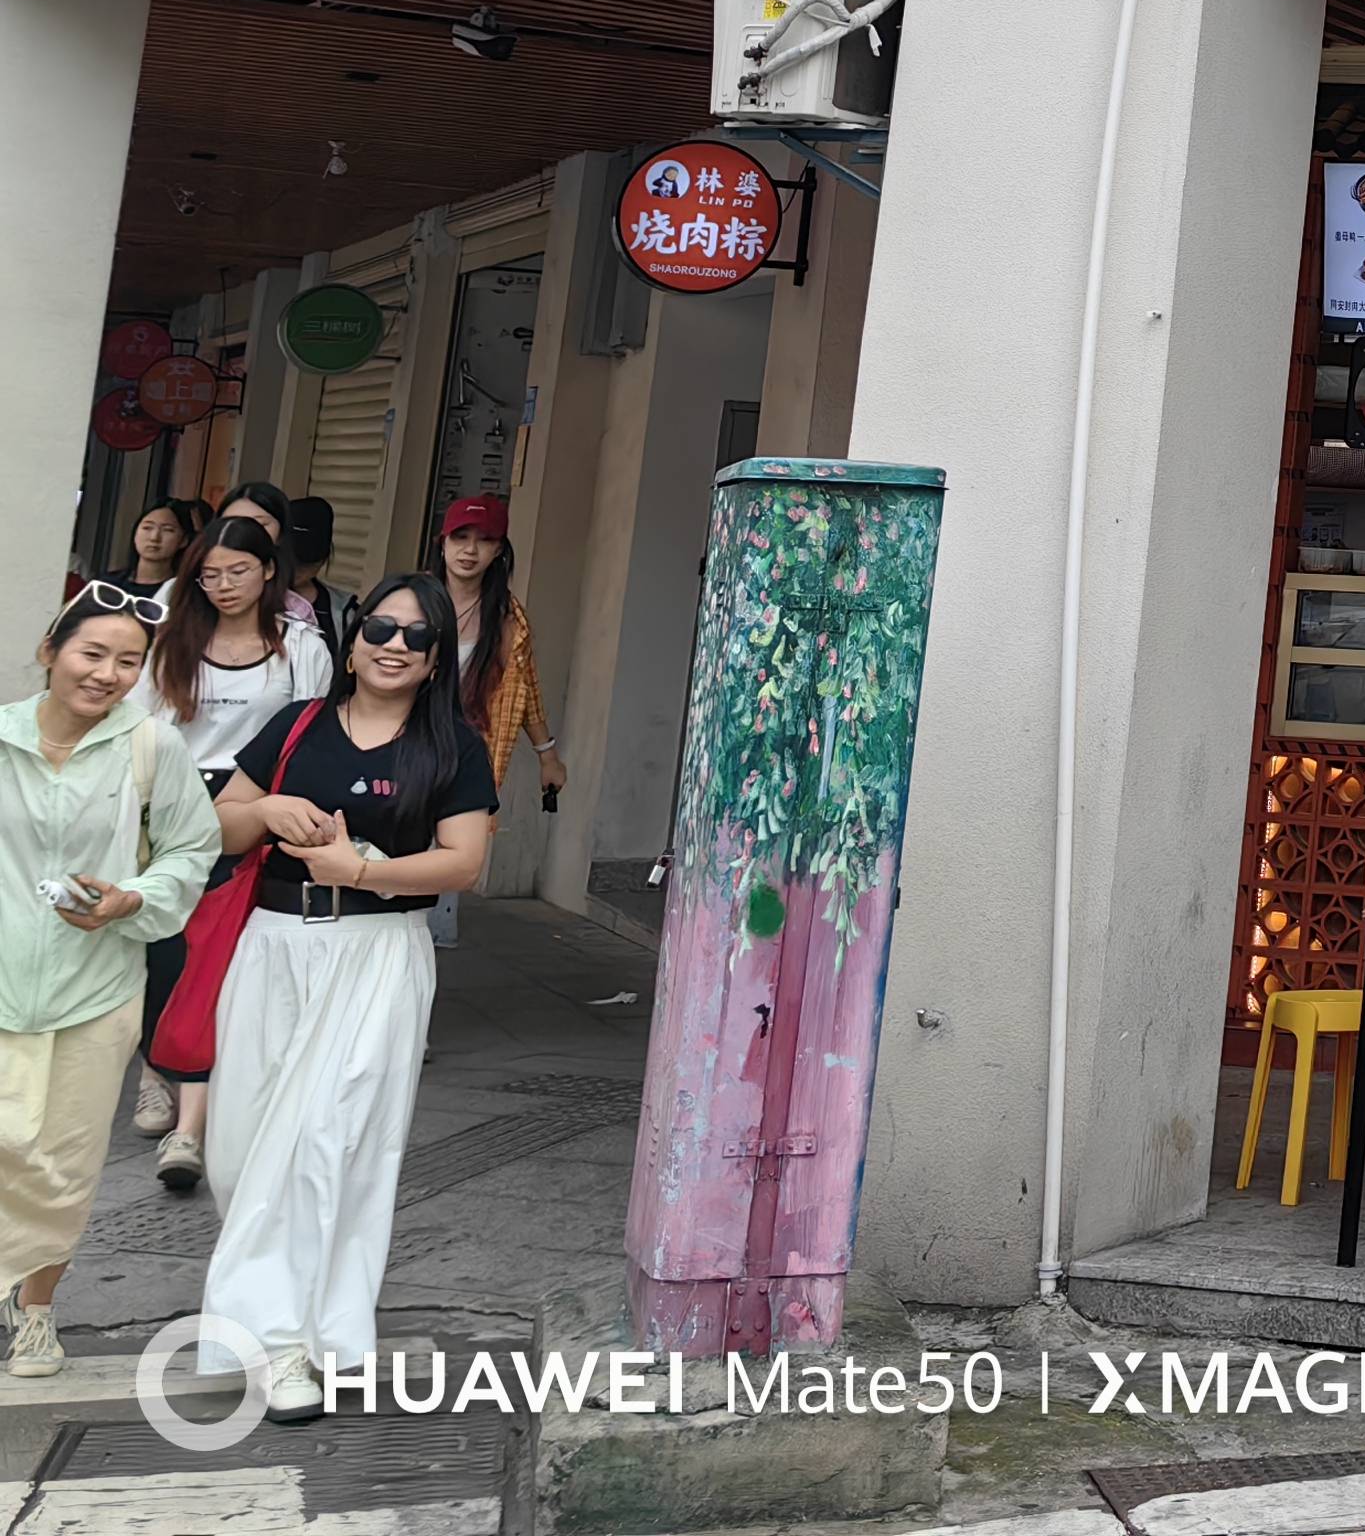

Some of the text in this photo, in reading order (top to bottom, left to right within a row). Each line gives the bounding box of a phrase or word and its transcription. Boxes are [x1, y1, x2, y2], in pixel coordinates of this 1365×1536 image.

[694, 167, 761, 198] 林婆
[699, 196, 725, 206] LIN
[630, 209, 767, 260] 烧肉粽
[650, 263, 737, 279] SHAOROUZONG
